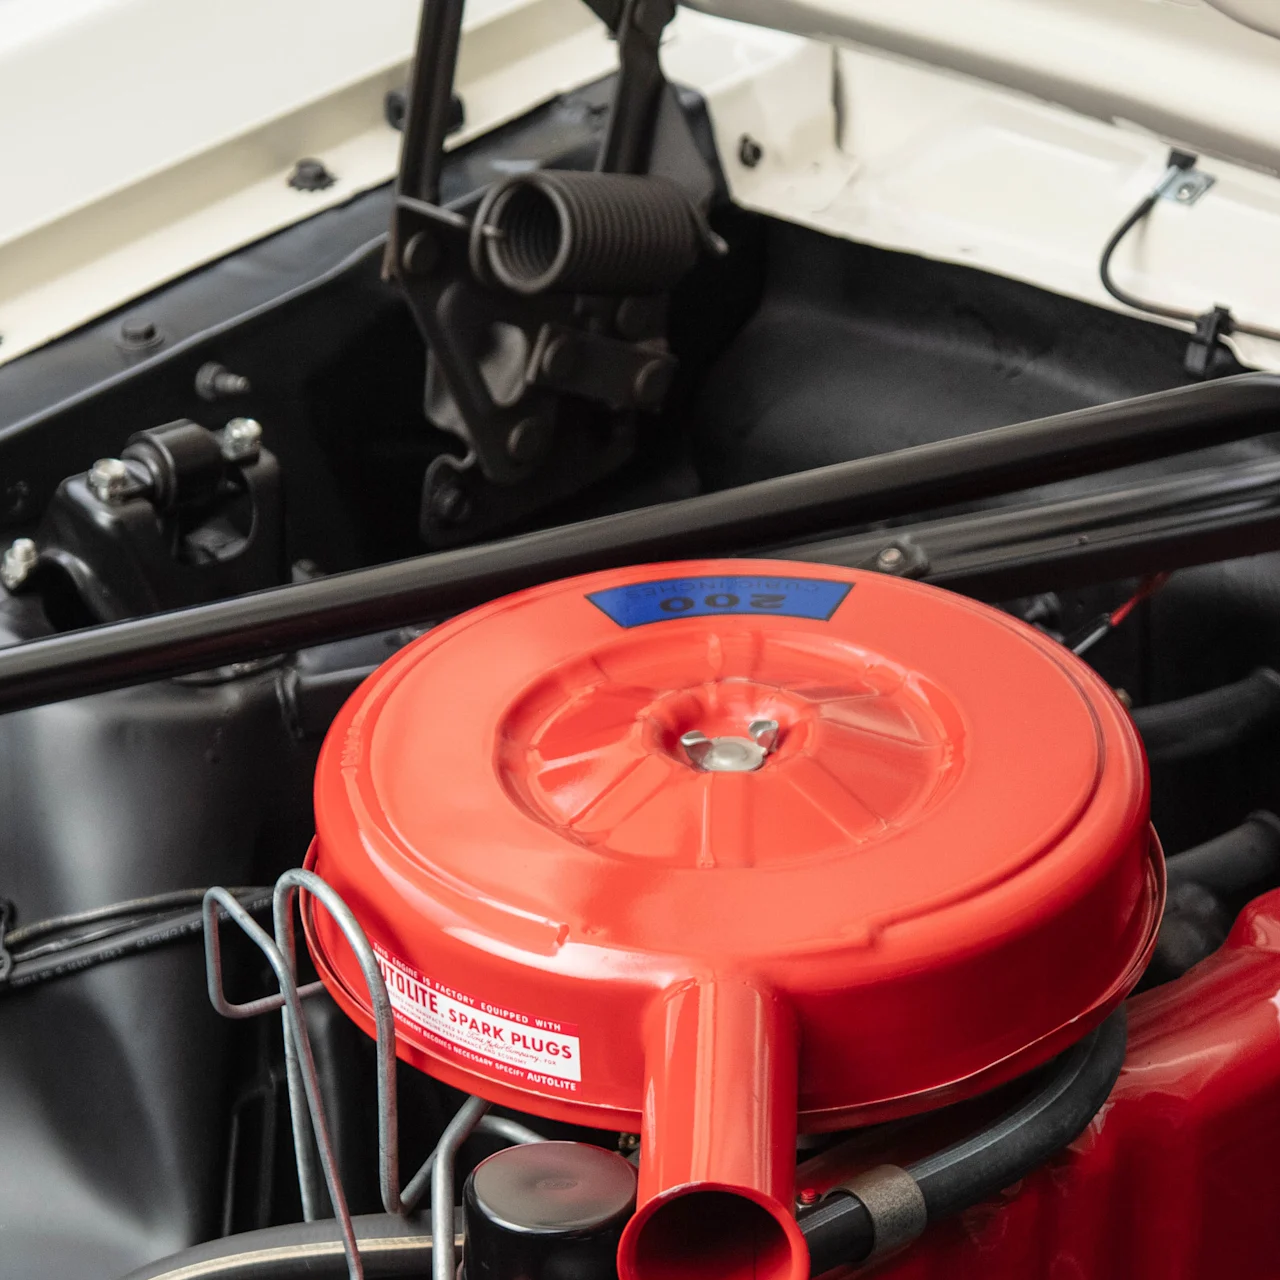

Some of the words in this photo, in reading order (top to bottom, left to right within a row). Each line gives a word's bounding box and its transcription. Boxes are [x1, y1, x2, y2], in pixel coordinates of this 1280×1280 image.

[659, 593, 787, 613] 200
[374, 942, 389, 960] THIS
[392, 957, 418, 979] ENGINE
[422, 976, 431, 986] IS
[435, 982, 475, 1006] FACTORY
[481, 1002, 529, 1024] EQUIPPED
[535, 1018, 561, 1032] WITH
[377, 958, 439, 1014] UTOLITE
[448, 1008, 505, 1042] SPARK
[511, 1031, 573, 1060] PLUGS
[423, 1029, 452, 1050] BECOMES
[453, 1046, 493, 1067] NECESSARY
[494, 1062, 525, 1077] SPECIFY
[526, 1072, 577, 1091] AUTOLITE
